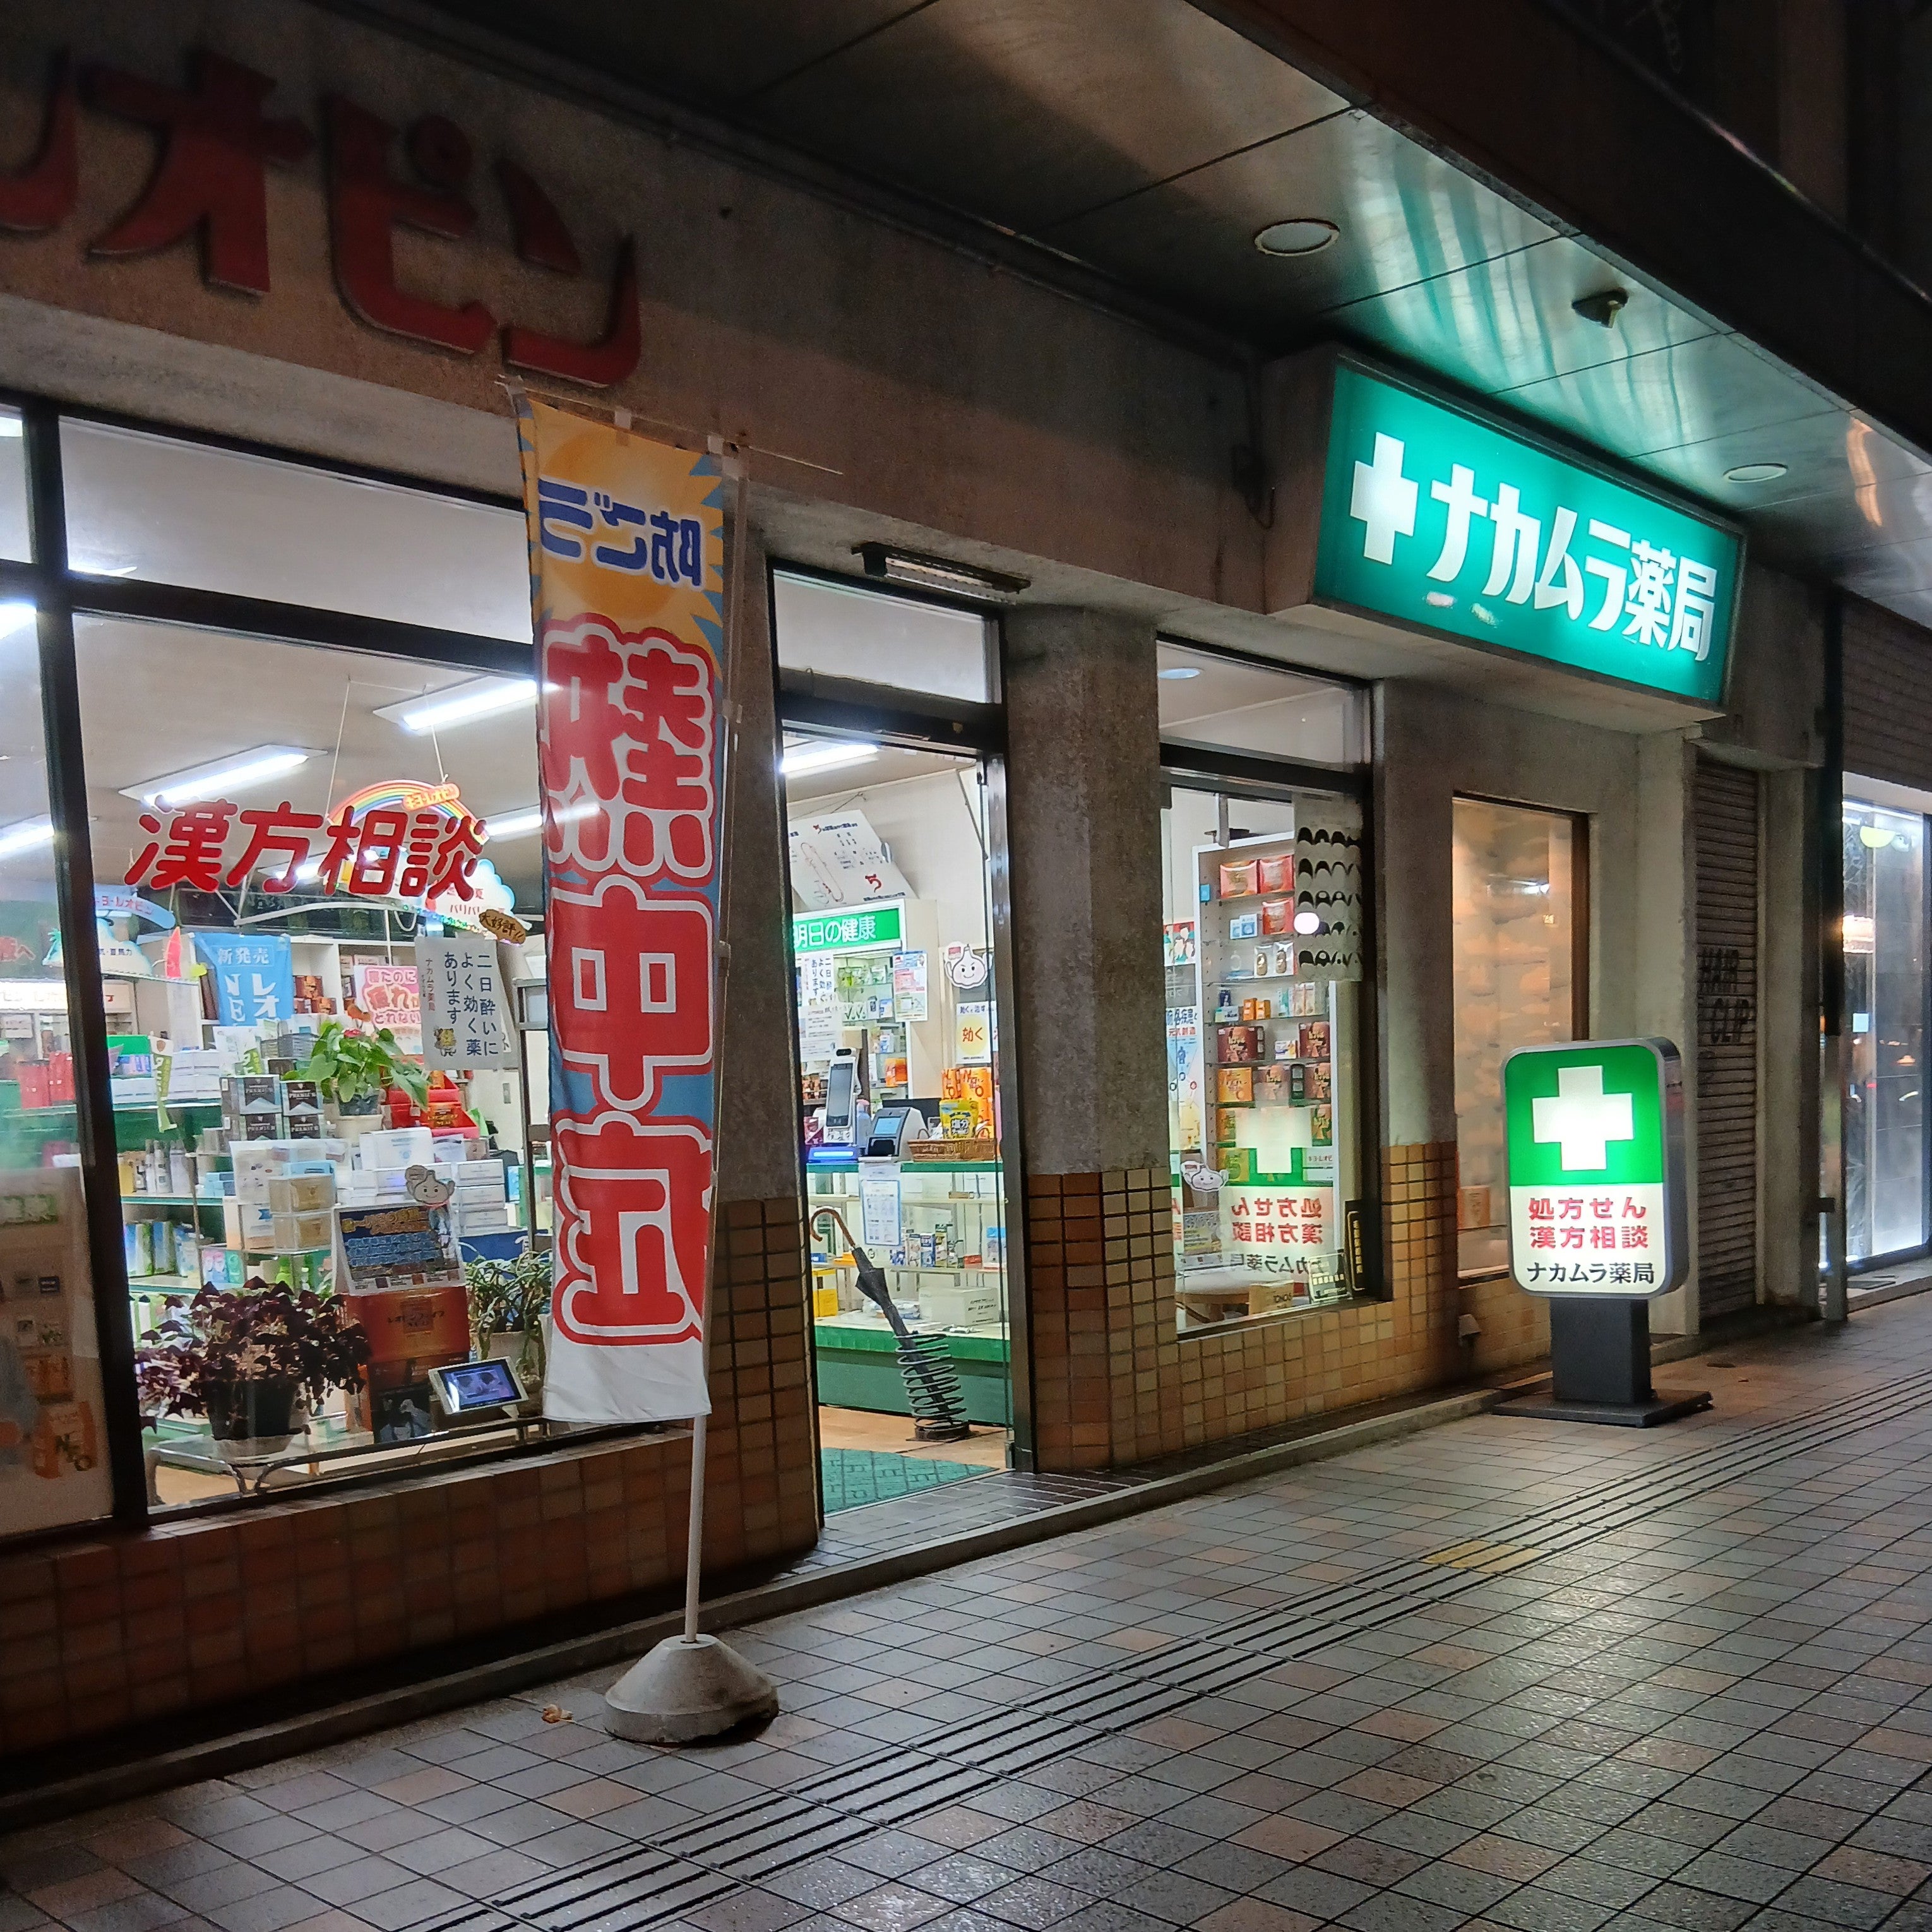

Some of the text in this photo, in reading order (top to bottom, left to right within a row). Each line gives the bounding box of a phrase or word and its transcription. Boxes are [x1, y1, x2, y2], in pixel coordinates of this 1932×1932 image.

[1426, 462, 1717, 661] ナカムラ薬局
[123, 795, 487, 902] 漢方相談
[217, 947, 269, 965] 新発売
[224, 972, 246, 1027] NE
[444, 951, 462, 1024] あります
[461, 951, 482, 1056] よく効く薬
[477, 954, 499, 1056] 二日酔いに
[962, 1027, 984, 1042] 効く
[1527, 1197, 1647, 1220] 処方せん
[1529, 1224, 1649, 1250] 漢方相談
[1526, 1261, 1655, 1284] ナカムラ薬局
